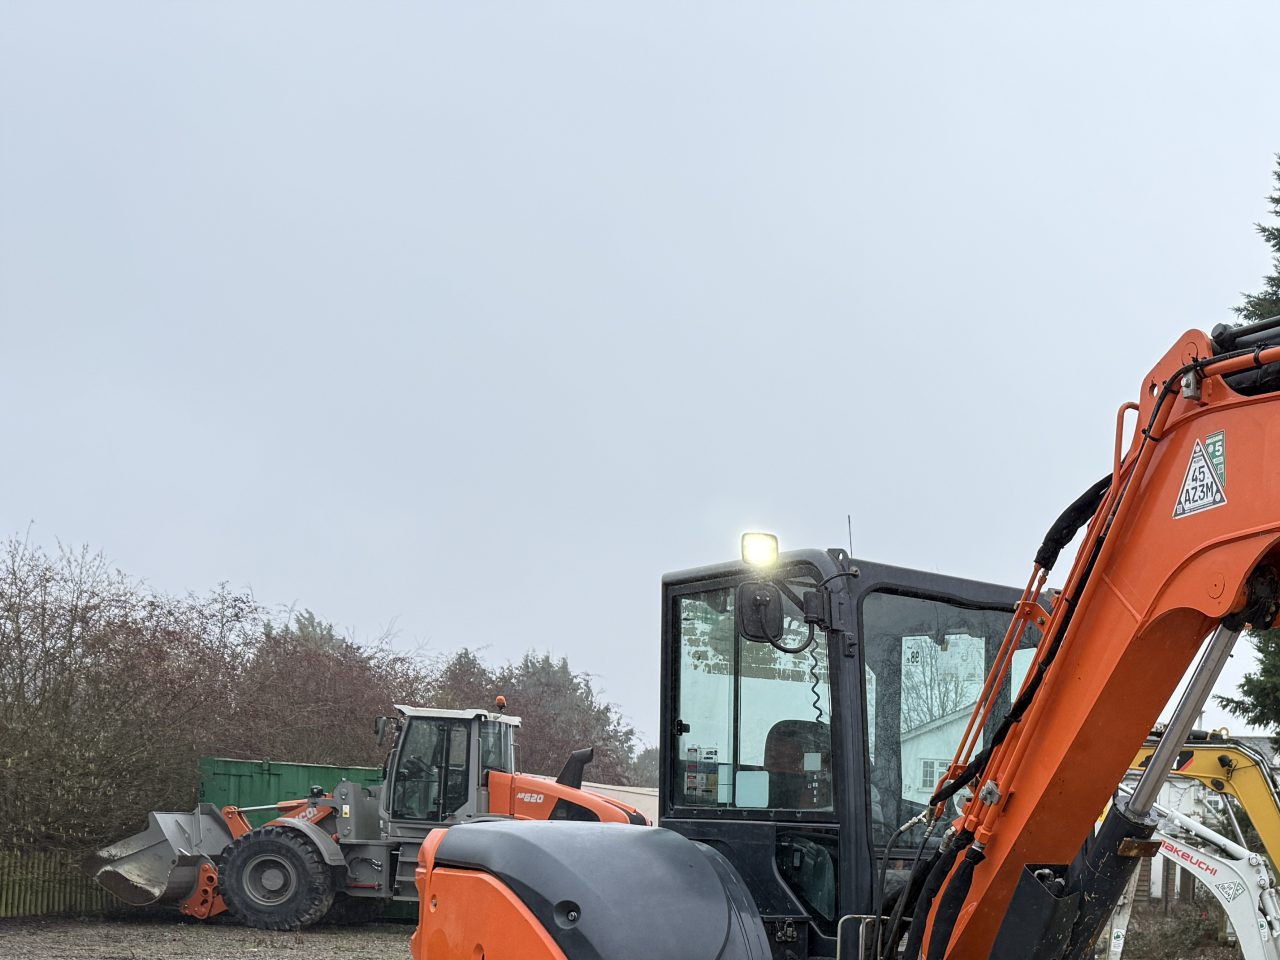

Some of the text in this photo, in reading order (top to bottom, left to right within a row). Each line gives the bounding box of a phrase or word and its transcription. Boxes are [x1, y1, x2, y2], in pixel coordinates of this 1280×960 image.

[1215, 441, 1222, 456] 5
[1192, 466, 1205, 485] 45
[1184, 481, 1214, 505] AZ3M
